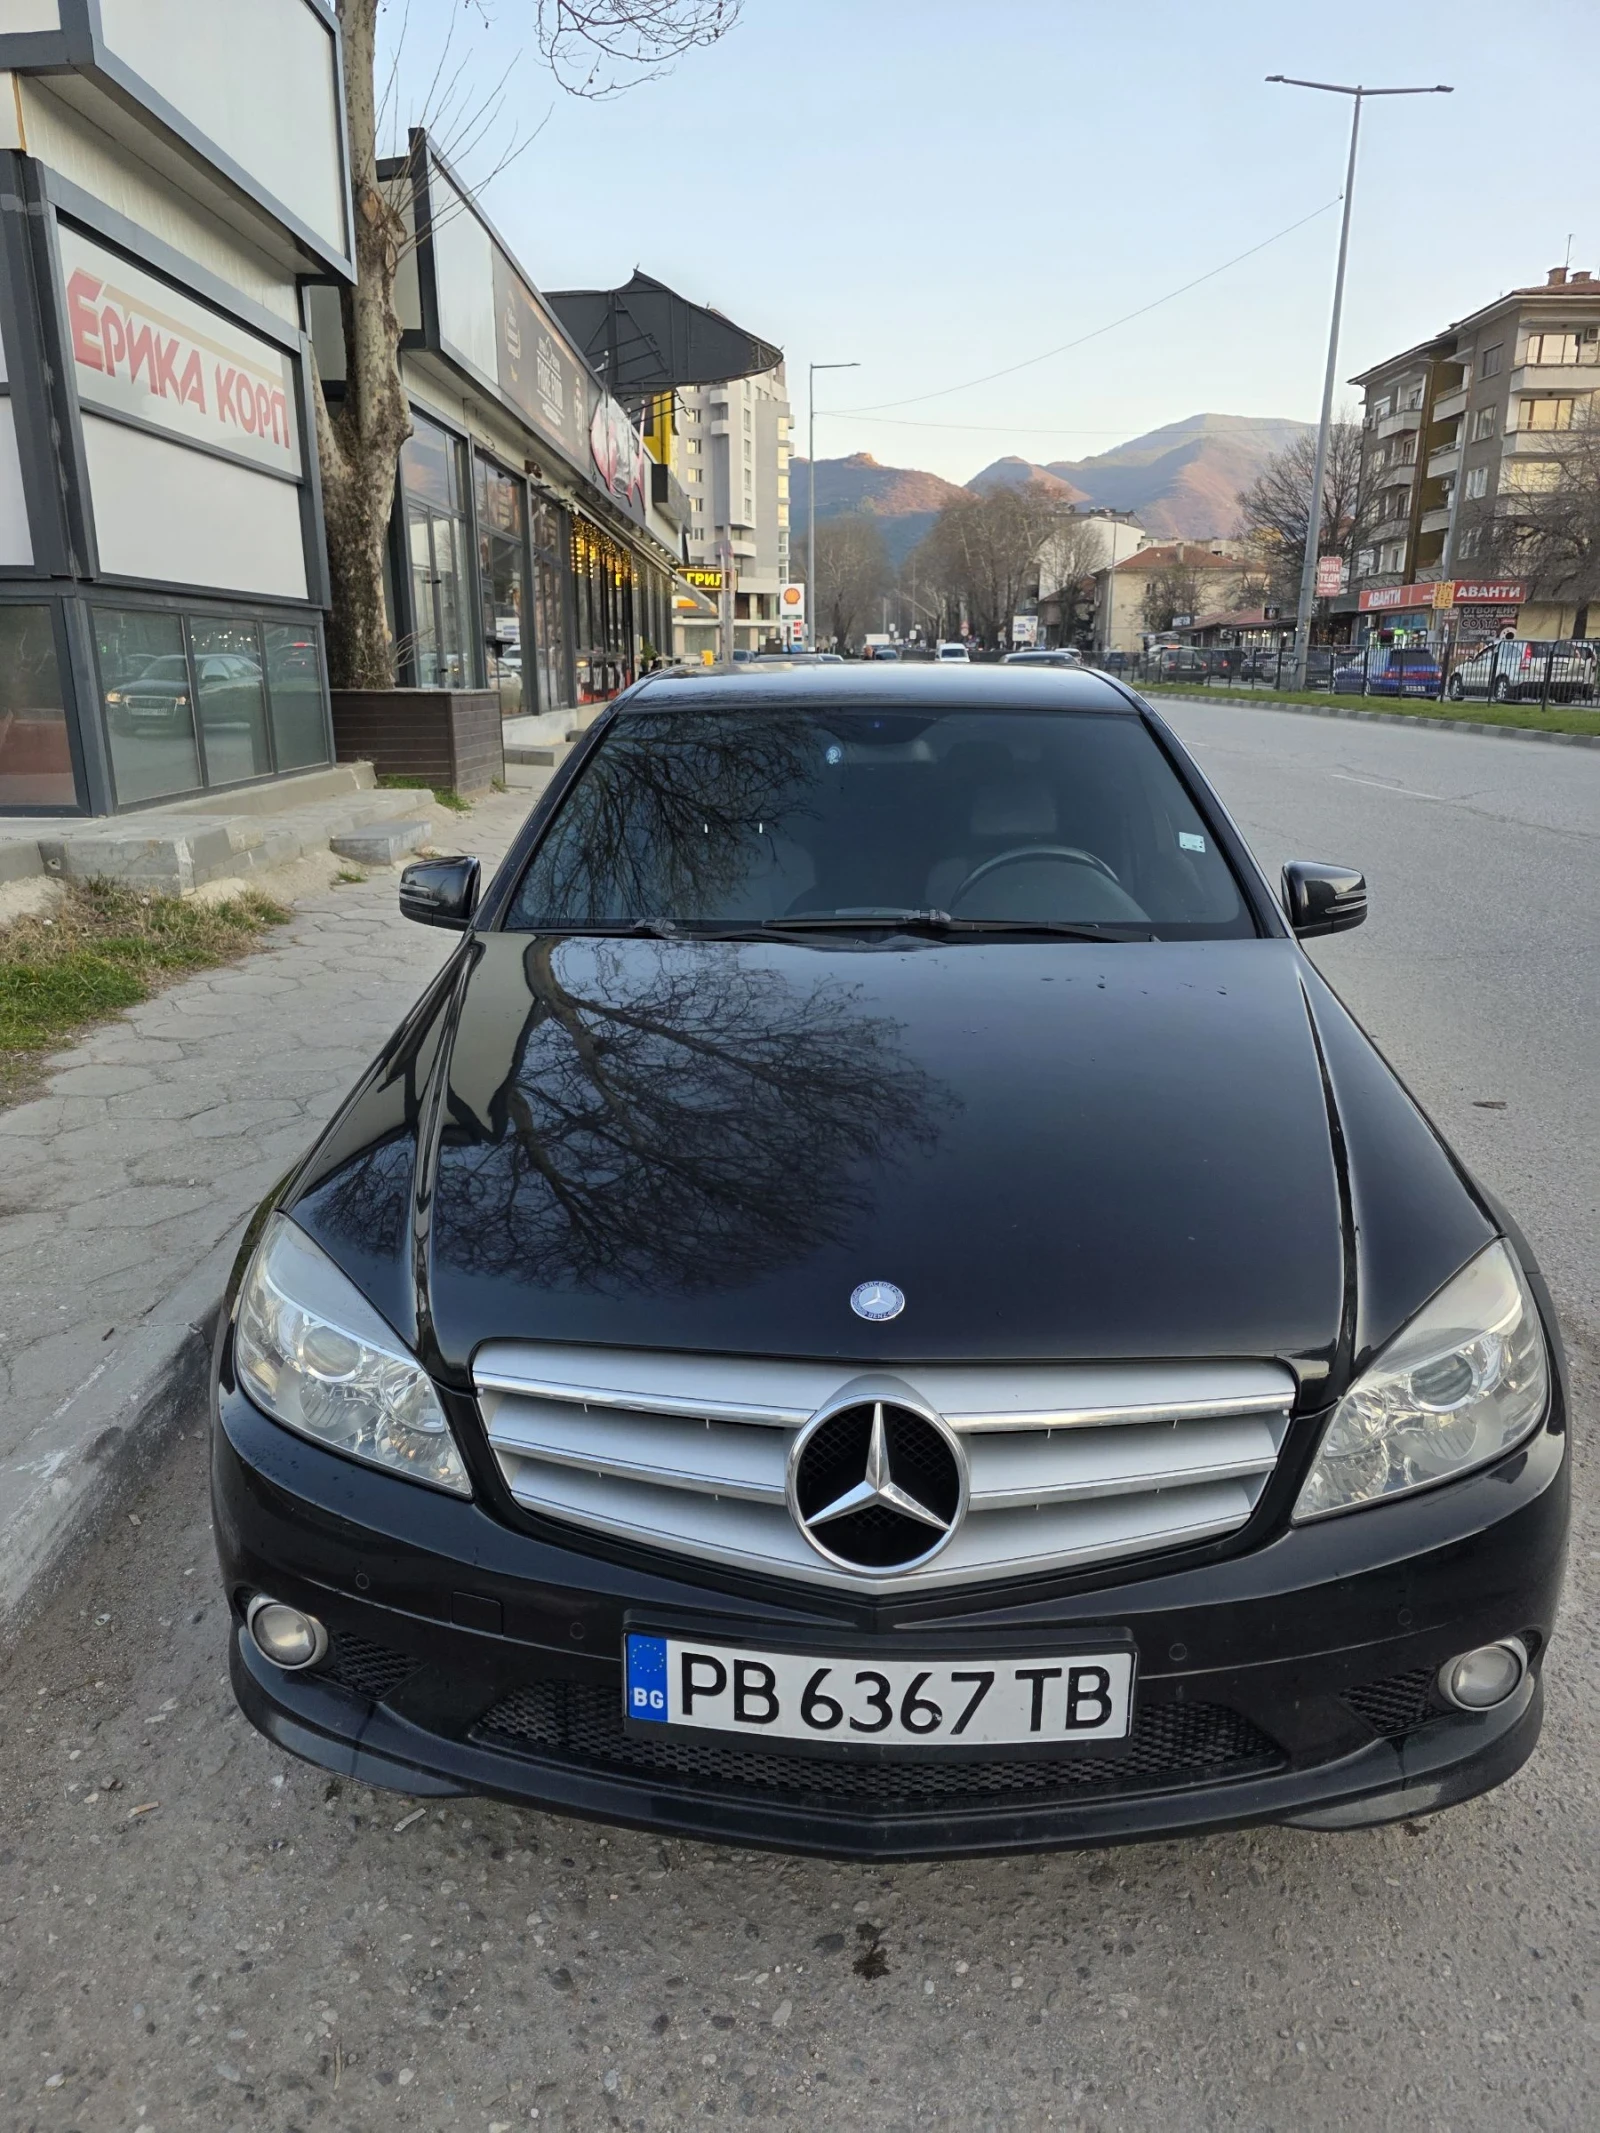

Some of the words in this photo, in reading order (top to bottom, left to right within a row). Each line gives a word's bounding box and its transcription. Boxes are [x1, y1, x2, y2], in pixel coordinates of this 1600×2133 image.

[66, 269, 206, 414] ЕРИКА
[215, 361, 290, 449] КОРП
[1320, 563, 1340, 572] HOTEL
[1367, 589, 1401, 608] АВАНТИ
[1456, 586, 1520, 598] АВАНТИ
[1463, 606, 1517, 614] ОТВОРЕНО
[1461, 618, 1500, 630] COSTA
[633, 1687, 664, 1709] BG
[681, 1652, 780, 1723] PB
[800, 1666, 995, 1735] 6367
[1014, 1665, 1113, 1732] TB
